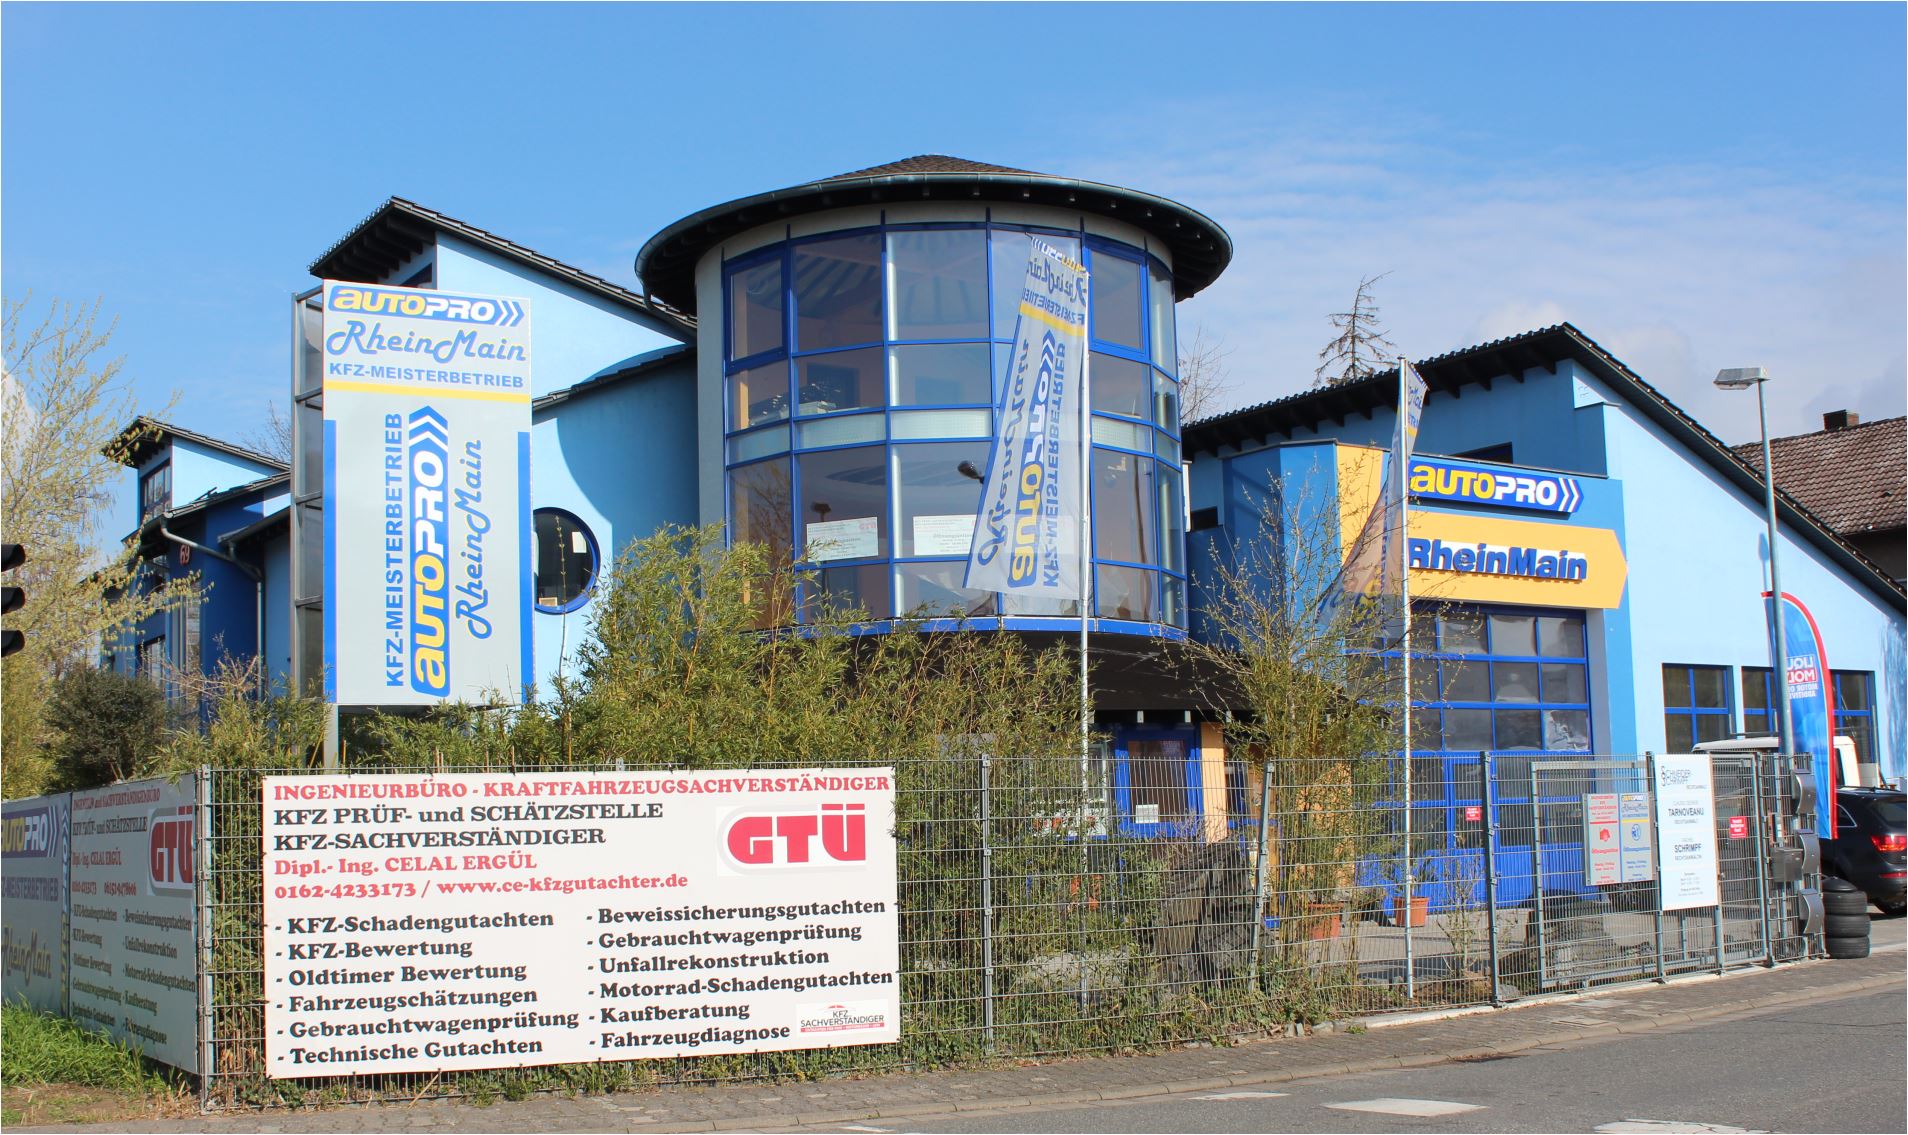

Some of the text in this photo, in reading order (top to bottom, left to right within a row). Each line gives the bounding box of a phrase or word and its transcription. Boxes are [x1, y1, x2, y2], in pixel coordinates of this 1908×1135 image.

[326, 320, 526, 364] RheinMain
[329, 362, 523, 388] KFZ-MEISTERBETRIEB
[385, 413, 405, 687] KFZ-MEISTERBETRIEB
[455, 439, 493, 640] RheinMain
[179, 545, 190, 565] 69
[1408, 537, 1587, 581] RheinMain
[274, 779, 467, 800] INGENIEURBÜRO
[484, 774, 889, 797] KRAFTFAHRZEUGSACHVERSTÄNDIGER
[274, 802, 663, 825] KFZ PRÜF- und SCHÄTZSTELLE
[151, 806, 193, 884] GTÜ
[274, 827, 606, 851] KFZ-SACHVERSTÄNDIGER
[727, 803, 866, 864] GTÜ
[275, 850, 537, 877] Dipl.- Ing. CELAL ERGÜL
[275, 883, 416, 899] 0162-4233173
[438, 874, 688, 895] www.ce-kfzgutachter.de
[288, 912, 553, 934] KFZ-Schadengutachten
[598, 900, 886, 924] Beweissicherungsgutachten
[598, 924, 862, 948] Gebrauchtwagenprüfung
[288, 940, 473, 960] KFZ-Bewertung
[599, 950, 829, 973] Unfallrekonstruktion
[289, 967, 395, 986] Oldtimer
[401, 963, 527, 982] Bewertung
[600, 971, 893, 999] Motorrad-Schadengutachten
[289, 989, 538, 1013] Fahrzeugschätzungen
[600, 1002, 750, 1023] Kaufberatung
[290, 1011, 579, 1037] Gebrauchtwagenprüfung
[833, 1010, 848, 1018] KFZ
[602, 1026, 790, 1049] Fahrzeugdiagnose
[290, 1044, 419, 1064] Technische
[424, 1038, 542, 1060] Gutachten
